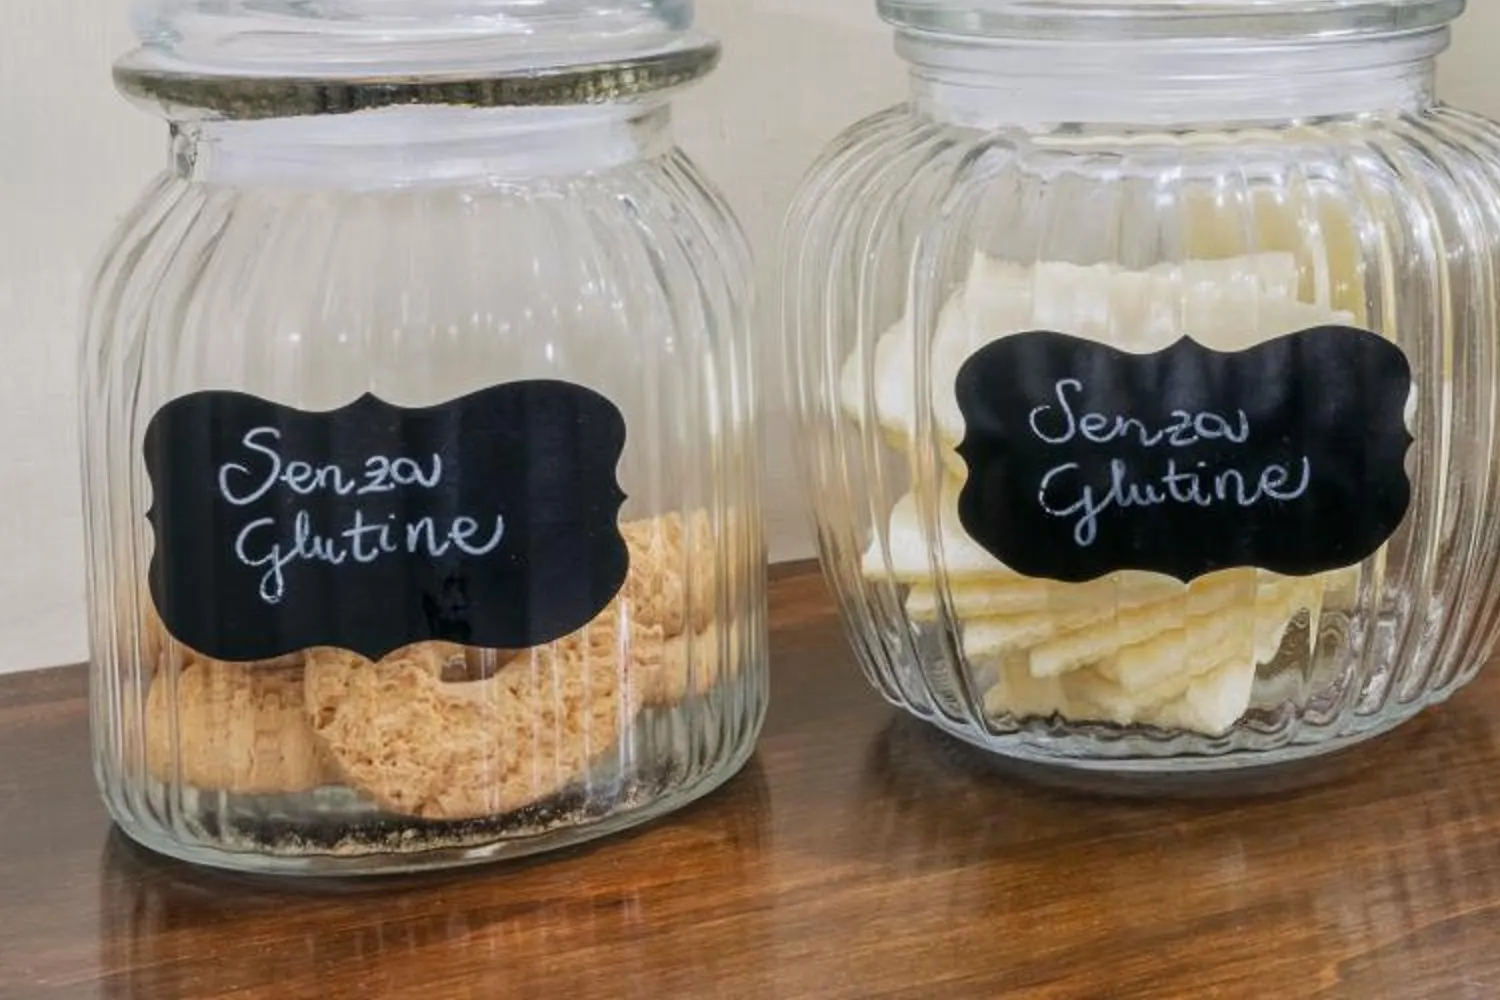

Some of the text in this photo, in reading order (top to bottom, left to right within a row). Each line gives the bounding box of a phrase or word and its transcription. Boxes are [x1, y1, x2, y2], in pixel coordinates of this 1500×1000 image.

[1029, 378, 1250, 447] Senza
[219, 427, 442, 505] Senza
[1037, 455, 1310, 548] Glutine
[234, 510, 504, 604] Glutine
